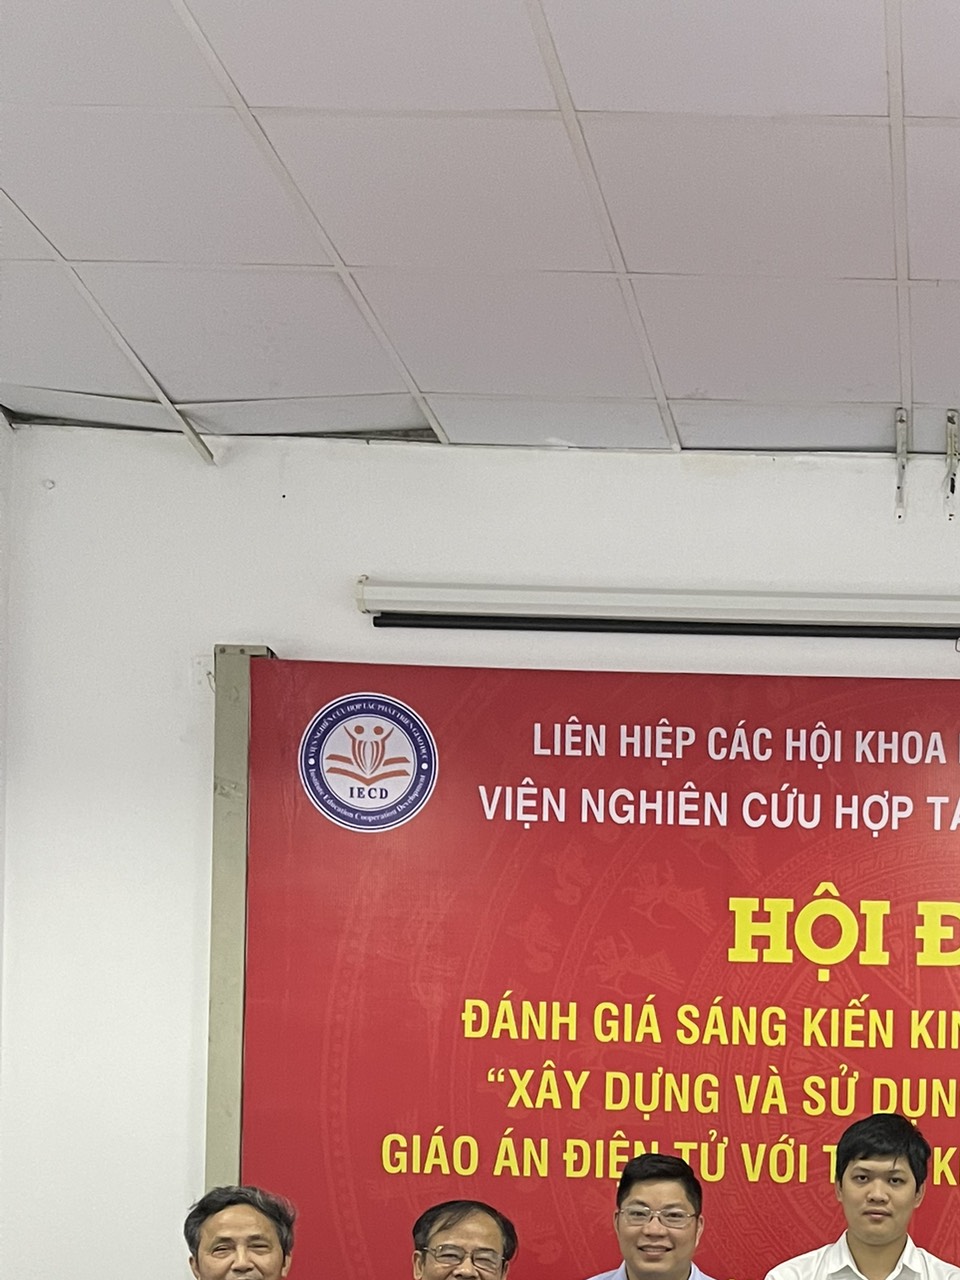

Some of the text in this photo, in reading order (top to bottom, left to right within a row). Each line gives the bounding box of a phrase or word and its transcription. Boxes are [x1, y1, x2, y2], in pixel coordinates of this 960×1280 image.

[533, 715, 606, 757] LIÊN
[619, 718, 696, 766] HIỆP
[707, 719, 772, 761] CÁC
[785, 721, 842, 770] HỘI
[855, 730, 947, 765] KHOA
[349, 786, 389, 799] IECD
[478, 776, 566, 830] VIỆN
[581, 781, 728, 827] NGHIÊN
[742, 783, 821, 829] CỨU
[835, 790, 914, 838] HỢP
[727, 881, 891, 982] HỘI
[461, 989, 577, 1041] ĐÁNH
[593, 994, 662, 1043] GIÁ
[676, 995, 787, 1047] SÁNG
[803, 993, 894, 1049] KIẾN
[604, 1066, 719, 1121] DỰNG
[734, 1065, 788, 1115] VÀ
[802, 1069, 860, 1117] SỬ
[381, 1126, 479, 1176] GIÁO
[493, 1127, 549, 1177] ÁN
[562, 1130, 659, 1188] ĐIỆ
[673, 1129, 729, 1182] TỬ
[740, 1133, 808, 1184] VỚI
